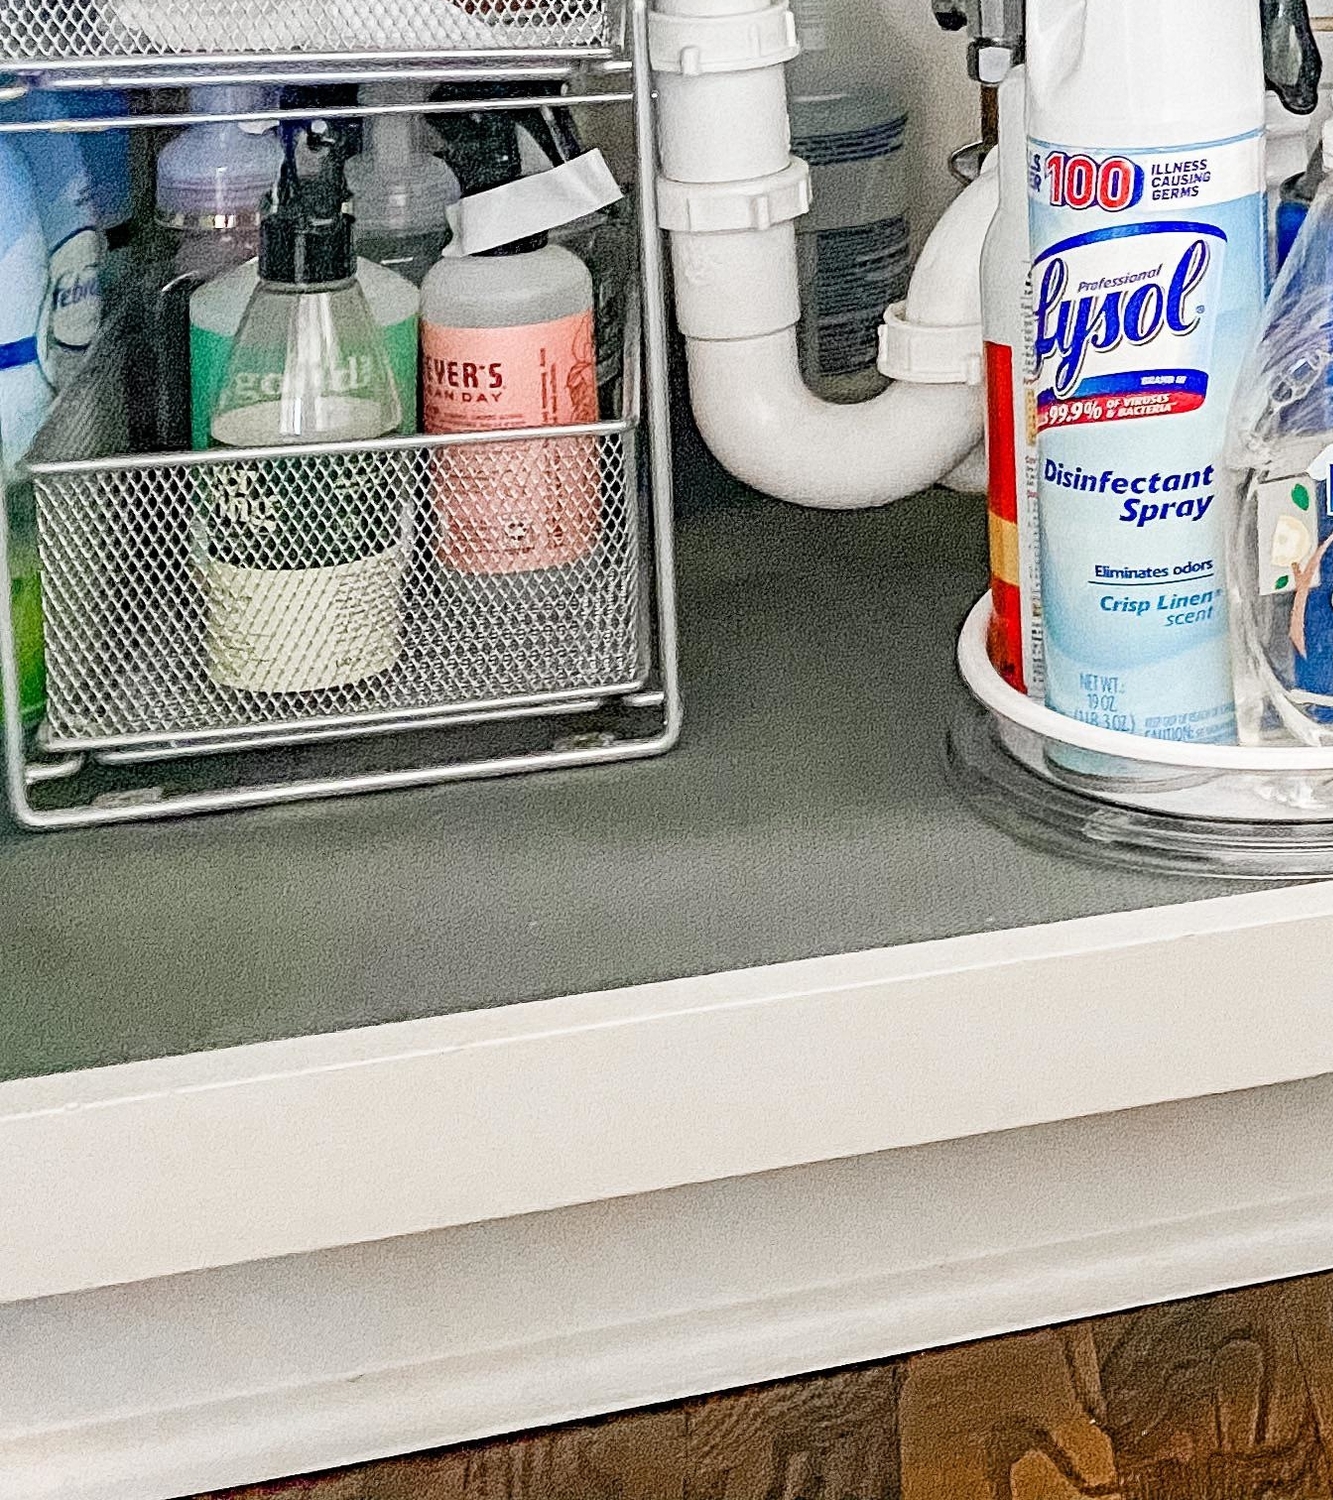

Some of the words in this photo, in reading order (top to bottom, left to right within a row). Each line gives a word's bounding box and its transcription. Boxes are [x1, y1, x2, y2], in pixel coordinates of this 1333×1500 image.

[1046, 152, 1137, 211] 100
[1151, 159, 1208, 175] ILLNESS
[1151, 172, 1211, 188] CAUSING
[1151, 186, 1200, 201] GERMS
[1077, 263, 1164, 293] Professional
[1035, 239, 1208, 394] Lysol
[425, 356, 503, 389] EYER'S
[462, 391, 502, 403] DAY
[1106, 399, 1121, 409] OF
[1123, 394, 1170, 408] VIRUSES
[1049, 401, 1103, 425] 99.9%
[1118, 403, 1172, 417] BACTERIA
[1044, 458, 1215, 494] Disinfectant
[1119, 494, 1215, 528] Spray
[1095, 564, 1169, 580] Eliminates
[1173, 558, 1213, 575] odors
[1100, 595, 1150, 616] Crisp
[1156, 589, 1213, 611] Linen
[1164, 606, 1213, 627] scent
[1079, 672, 1098, 692] NET
[1087, 693, 1099, 709] 19
